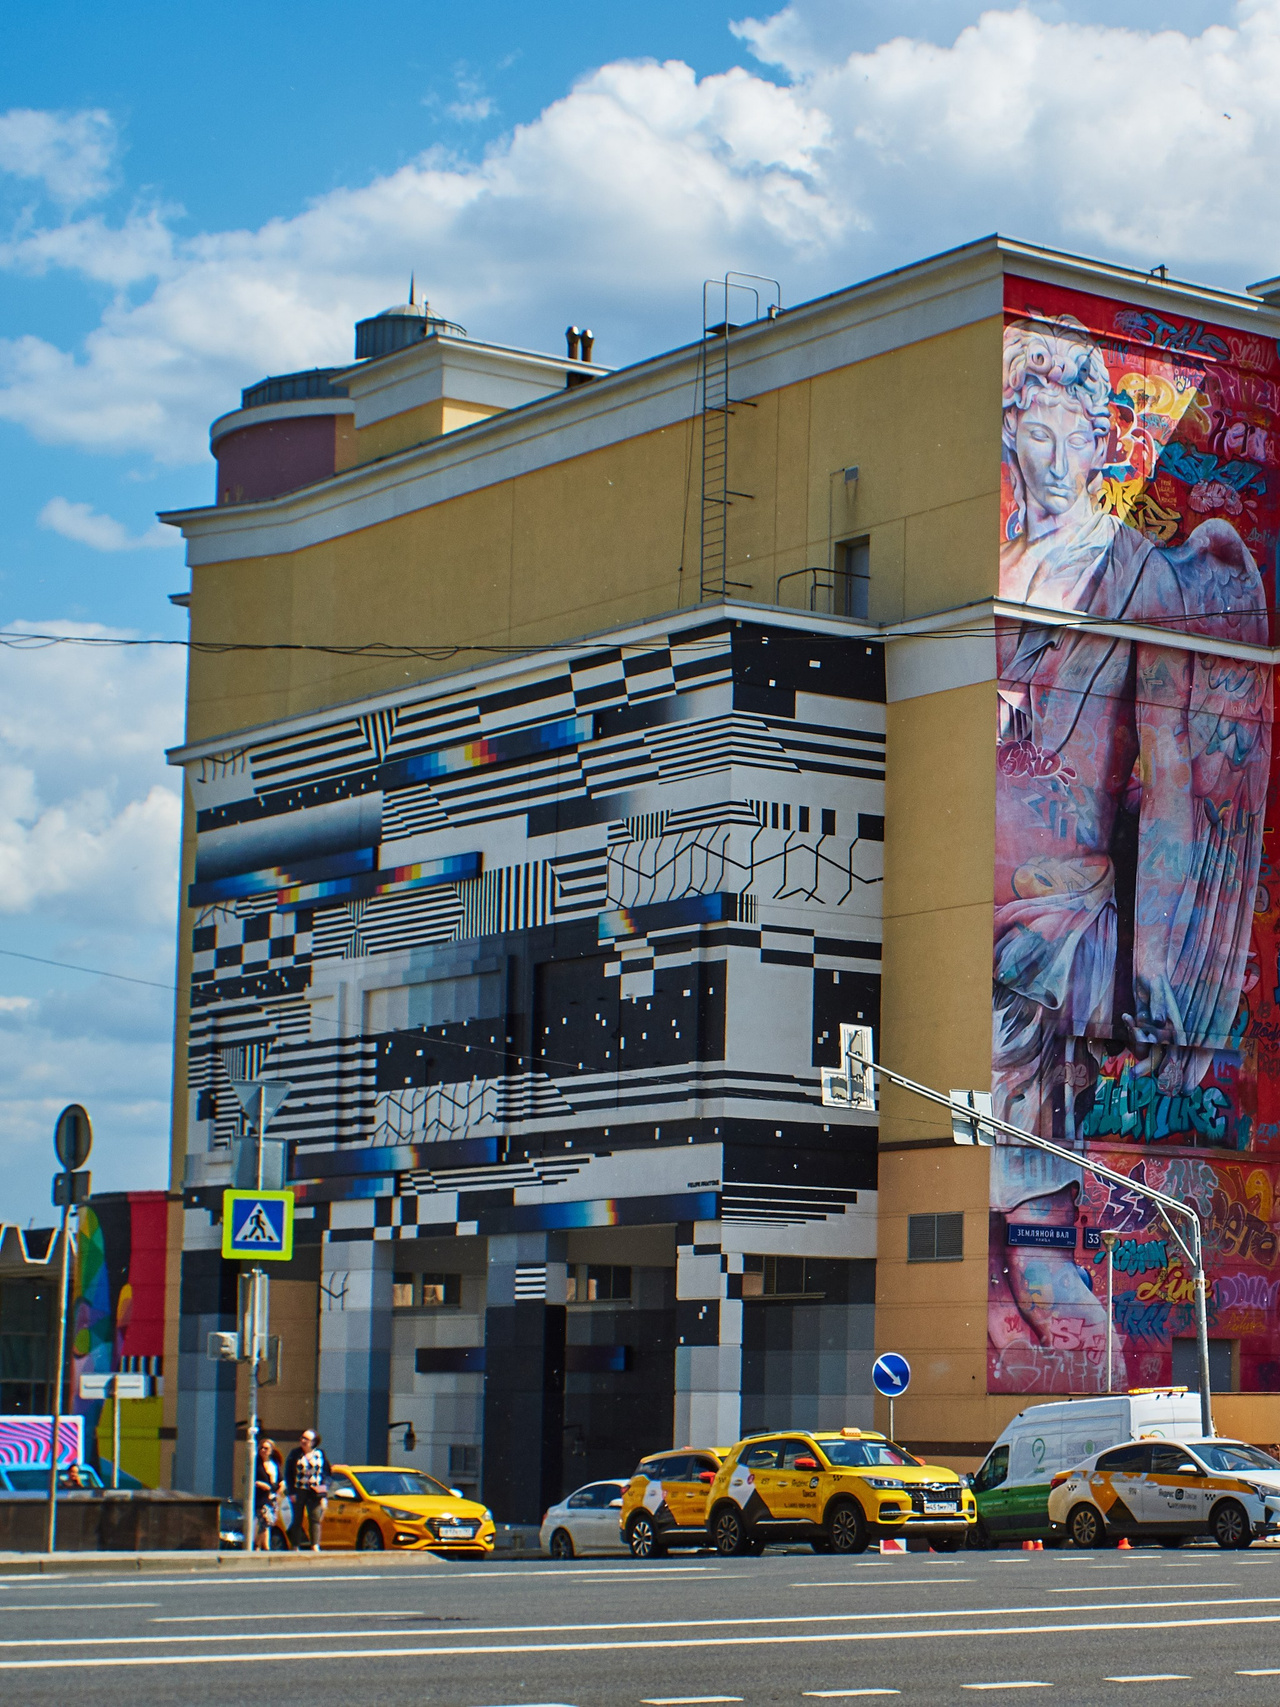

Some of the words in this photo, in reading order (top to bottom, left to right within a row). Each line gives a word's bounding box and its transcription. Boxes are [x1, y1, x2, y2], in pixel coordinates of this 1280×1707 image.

[1017, 1228, 1054, 1239] ЗЕМЛЯНОЙ
[1056, 1231, 1070, 1239] ВАЛ
[1087, 1233, 1100, 1244] 33
